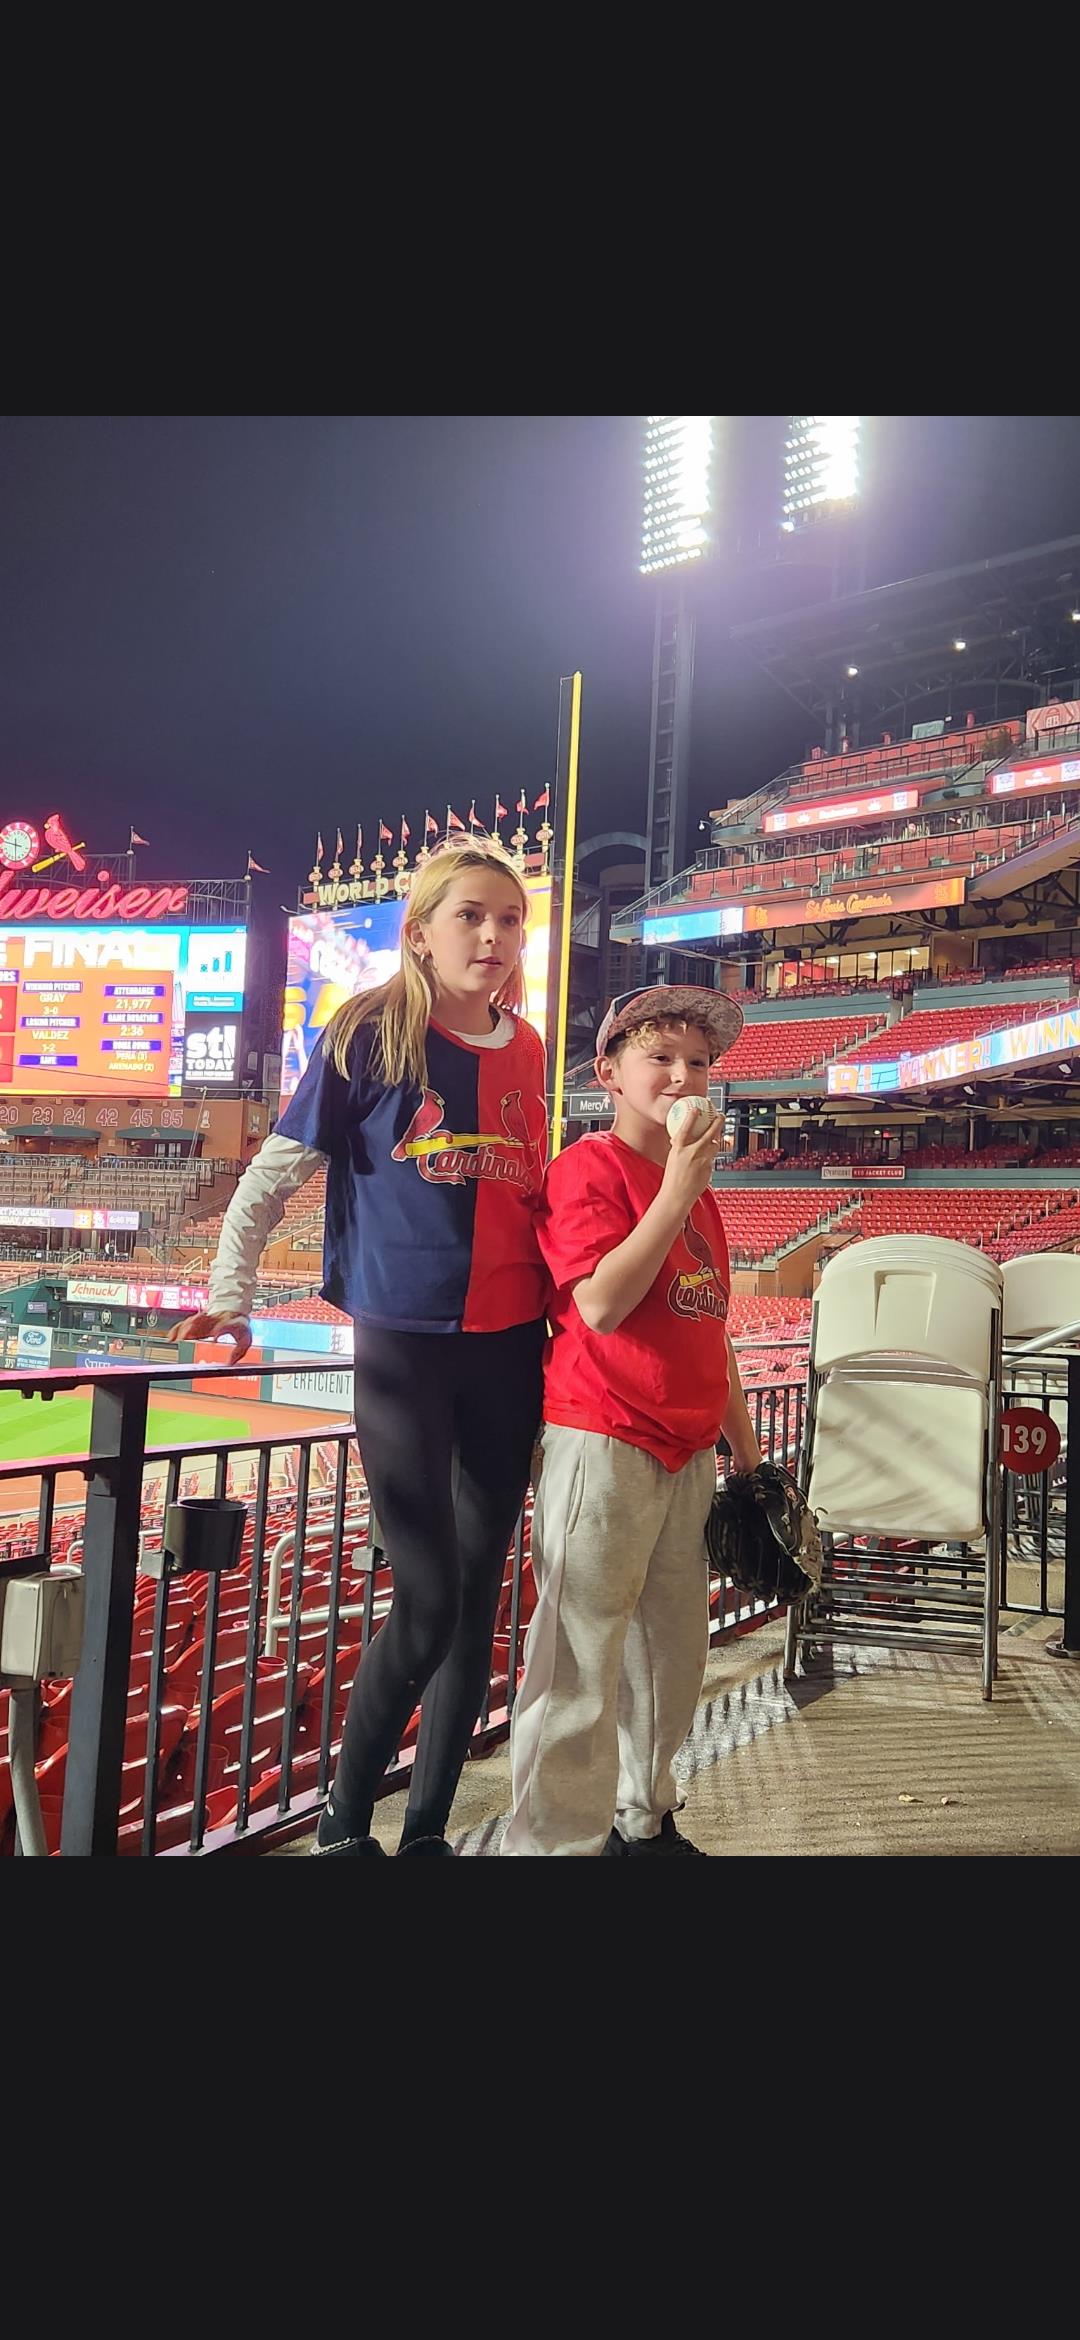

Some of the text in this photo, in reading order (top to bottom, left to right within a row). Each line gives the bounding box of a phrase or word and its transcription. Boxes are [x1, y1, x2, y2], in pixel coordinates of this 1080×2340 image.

[318, 877, 389, 906] WORLD
[116, 999, 152, 1009] 21,977
[32, 1030, 70, 1040] VALDEZ
[186, 1025, 237, 1059] stl
[186, 1059, 235, 1071] TODAY
[580, 1101, 604, 1112] Mercy
[0, 1107, 183, 1128] 20 23 24 42 45 85
[416, 1129, 532, 1189] Cardina
[71, 1283, 122, 1297] Schnucks
[668, 1269, 727, 1322] Cardina
[1001, 1424, 1047, 1455] 139
